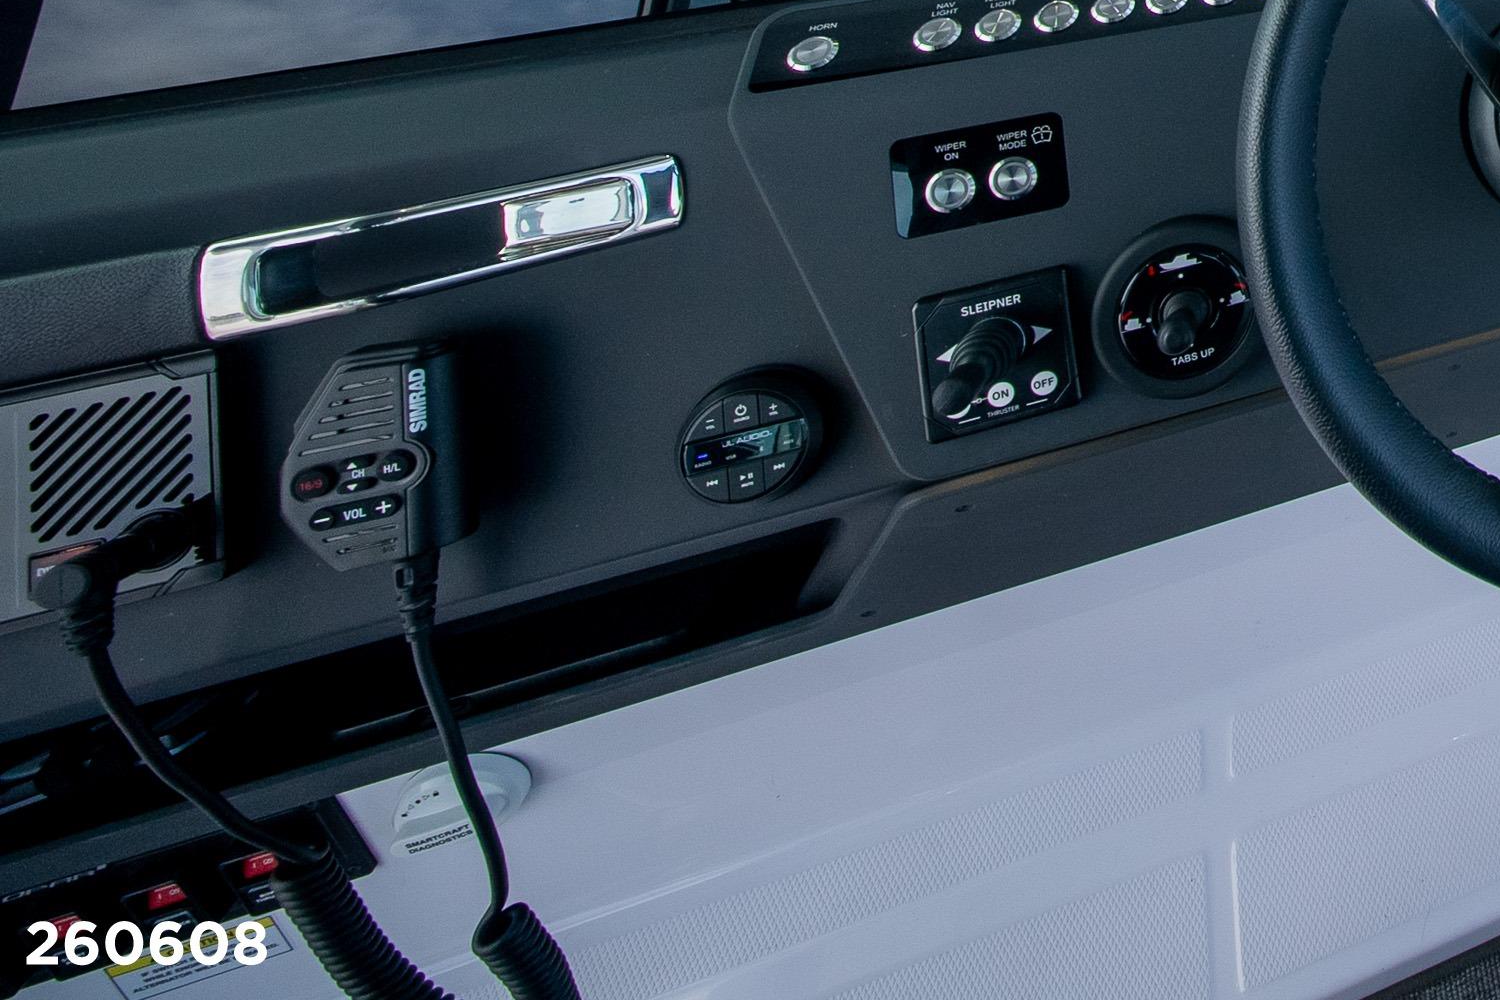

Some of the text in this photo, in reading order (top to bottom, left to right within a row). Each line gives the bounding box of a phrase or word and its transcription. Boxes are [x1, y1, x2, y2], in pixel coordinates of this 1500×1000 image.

[936, 1, 956, 10] NAV
[990, 0, 1017, 9] LIGHT
[931, 7, 960, 18] LIGHT
[808, 22, 838, 33] HORN
[996, 129, 1028, 143] WIPER
[934, 140, 967, 154] WIPER
[998, 139, 1027, 151] MODE
[944, 152, 960, 161] ON
[960, 293, 1022, 318] SLEIPNER
[1171, 347, 1215, 367] TABS UP
[1033, 376, 1054, 390] OFF
[992, 388, 1010, 401] ON
[408, 368, 427, 434] SIMRAD
[987, 404, 1020, 418] THRUSTER
[351, 468, 365, 479] CH
[383, 463, 401, 474] H/L
[299, 479, 323, 491] 16/9
[343, 508, 367, 520] VOL
[405, 824, 469, 849] SMARTCRAFT
[408, 829, 473, 854] DIAGNOSTICS
